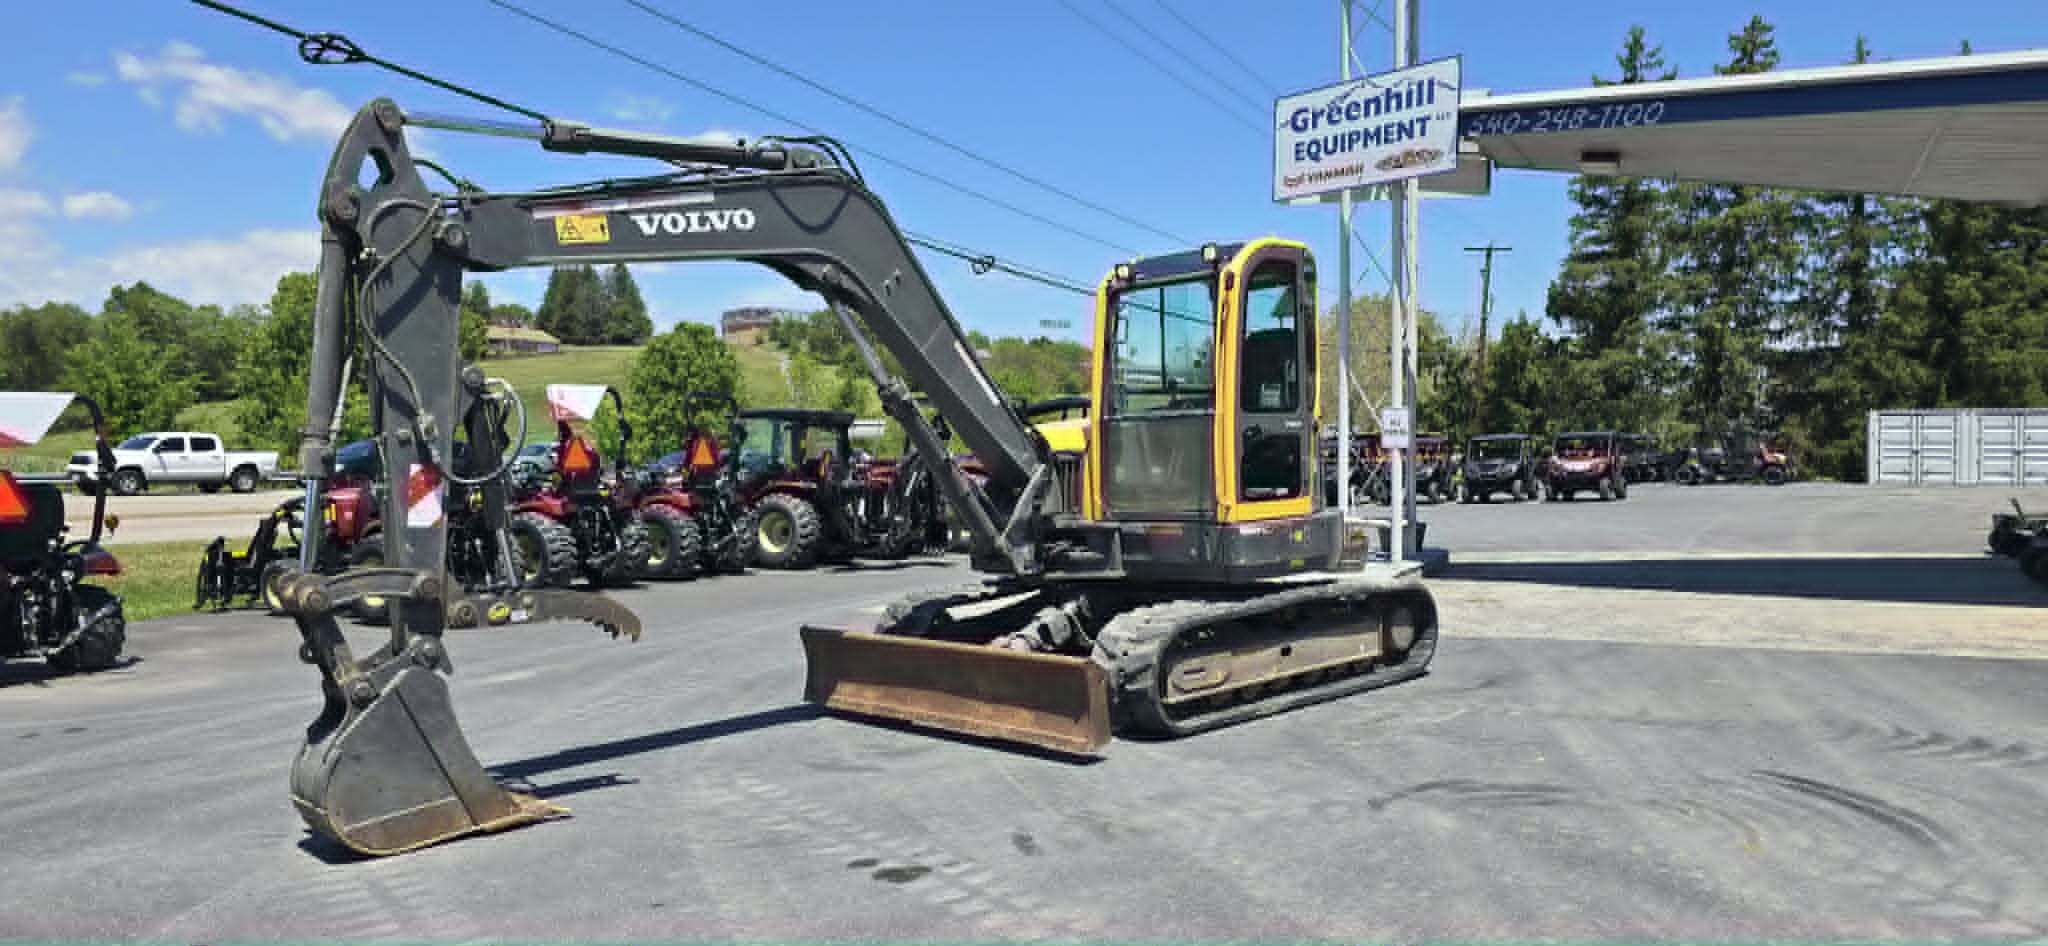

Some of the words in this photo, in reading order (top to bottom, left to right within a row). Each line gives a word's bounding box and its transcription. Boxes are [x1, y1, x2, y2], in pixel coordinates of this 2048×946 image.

[1290, 76, 1436, 133] Greenhill
[1467, 101, 1665, 137] 540-248-1100
[1294, 114, 1431, 162] EQUIPMENT
[630, 208, 756, 236] VOLVO
